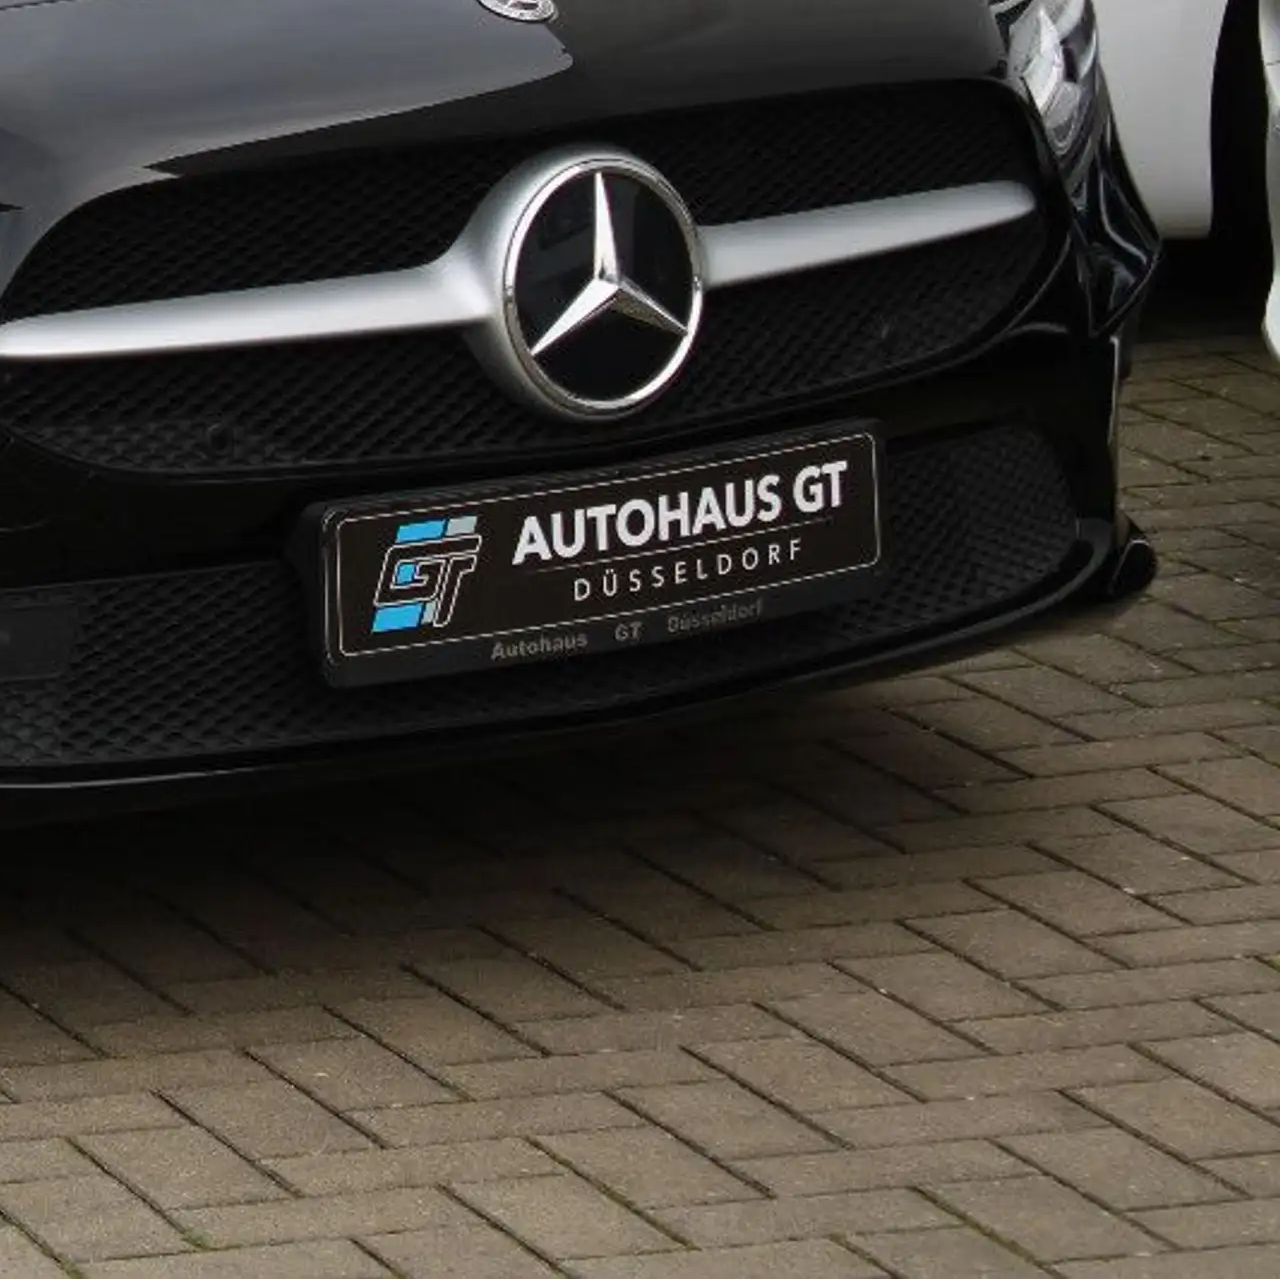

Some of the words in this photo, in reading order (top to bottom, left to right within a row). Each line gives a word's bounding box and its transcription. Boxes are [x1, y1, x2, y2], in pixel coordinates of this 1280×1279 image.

[511, 474, 783, 565] AUTOHAUS
[793, 460, 848, 513] GT
[573, 538, 802, 602] DÜSSELDORF
[490, 632, 589, 661] Autohaus
[614, 621, 642, 642] GT
